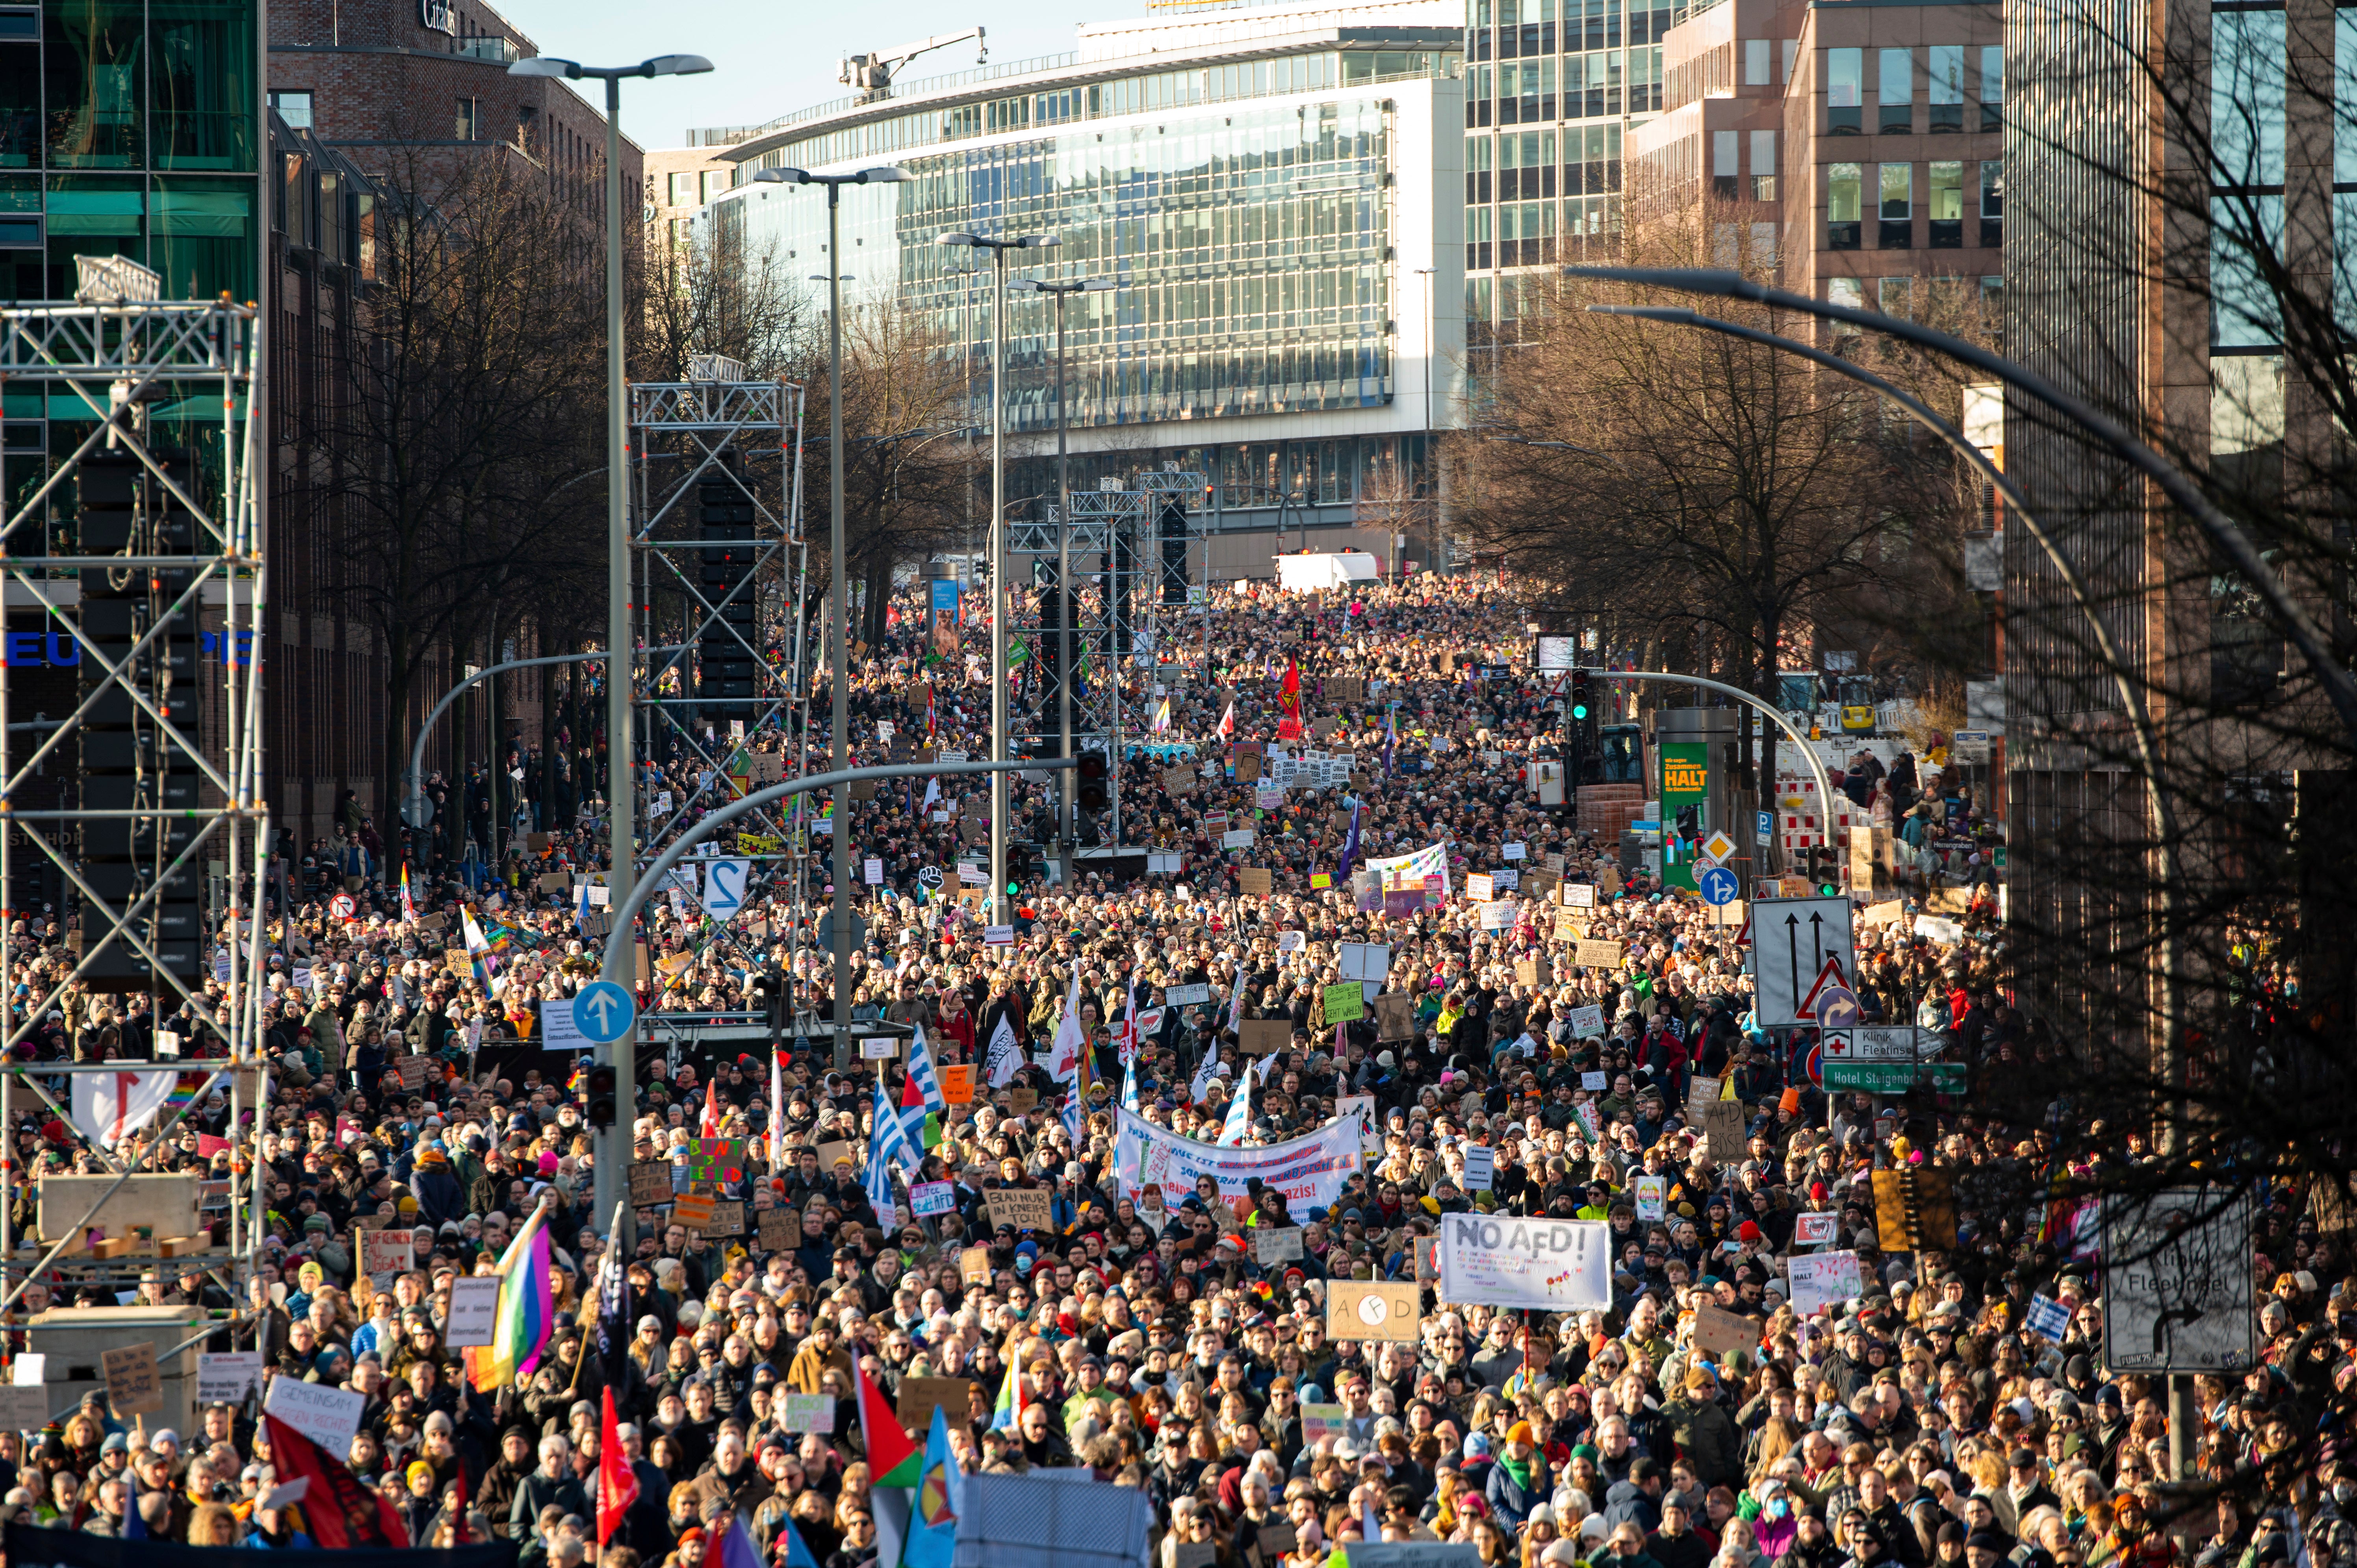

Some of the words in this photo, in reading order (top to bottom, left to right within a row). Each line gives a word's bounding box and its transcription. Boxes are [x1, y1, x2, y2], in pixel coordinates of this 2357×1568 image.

[1327, 678, 1348, 688] FCK
[1278, 729, 1299, 738] WIEDER
[1163, 768, 1177, 776] KEINE
[1165, 770, 1194, 782] RASSISTEN
[1665, 770, 1707, 787] HALT
[1759, 814, 1768, 830] P
[1933, 841, 1972, 850] Herrengraben
[774, 884, 789, 893] FCK
[1557, 914, 1568, 922] Die
[581, 916, 595, 935] NO
[1596, 942, 1620, 950] ZUSAMMEN
[1583, 949, 1603, 957] GEGEN
[1578, 956, 1614, 967] FASCHISMUS
[1327, 987, 1334, 996] Ob
[1347, 990, 1360, 1000] BITTE
[1325, 1008, 1341, 1019] GEHT
[1863, 1032, 1891, 1041] Klinik
[1863, 1045, 1912, 1055] Fleetinse
[402, 1056, 424, 1064] BUNTE
[1693, 1079, 1720, 1088] GEMEINSAM
[1835, 1071, 1860, 1084] Hotel
[404, 1080, 422, 1089] SUPPE
[1693, 1090, 1716, 1100] VIELFALT
[1707, 1102, 1741, 1127] AfD
[1576, 1112, 1595, 1141] KLIMASTREIK
[690, 1139, 741, 1156] BUNT
[1708, 1132, 1746, 1158] BÖSE!
[703, 1155, 722, 1165] IST
[1141, 1145, 1150, 1179] KLIMASTREIK
[1147, 1141, 1171, 1182] SPENDE
[1196, 1156, 1215, 1166] IST
[1218, 1160, 1257, 1169] KEINE
[630, 1165, 647, 1179] DIE
[648, 1163, 666, 1175] AFD
[1264, 1152, 1355, 1184] VERBRECHEN!
[690, 1166, 742, 1183] GESUND
[206, 1195, 226, 1204] 1933
[631, 1188, 651, 1204] MICH
[989, 1191, 1018, 1204] BLAU
[1020, 1193, 1046, 1205] NUR
[1641, 1189, 1654, 1198] PLATZ
[934, 1193, 955, 1210] AFD
[768, 1209, 792, 1219] AFD
[993, 1204, 1005, 1215] IN
[1009, 1203, 1049, 1215] KNEIPE
[726, 1212, 740, 1221] INS
[1008, 1213, 1043, 1226] TOLL!
[703, 1224, 727, 1236] KNIE!
[761, 1228, 774, 1238] IST
[781, 1227, 795, 1236] SO
[1456, 1219, 1502, 1250] NO
[362, 1231, 381, 1245] AUF
[382, 1232, 411, 1245] KEINEN
[768, 1237, 796, 1248] 1933
[362, 1244, 383, 1258] FALL
[362, 1255, 405, 1272] DIGGA!
[1794, 1273, 1813, 1281] HALT
[456, 1282, 495, 1291] Demokratie
[1362, 1286, 1383, 1295] genau
[1389, 1284, 1409, 1293] hin!
[1831, 1276, 1860, 1297] AFD
[1334, 1299, 1349, 1317] A
[1368, 1296, 1381, 1318] F
[1395, 1299, 1410, 1318] D
[2120, 1353, 2152, 1367] FUNK25
[279, 1385, 353, 1411] GEMEINSAM
[273, 1405, 310, 1424] GEGEN
[313, 1412, 351, 1434] RECHTS
